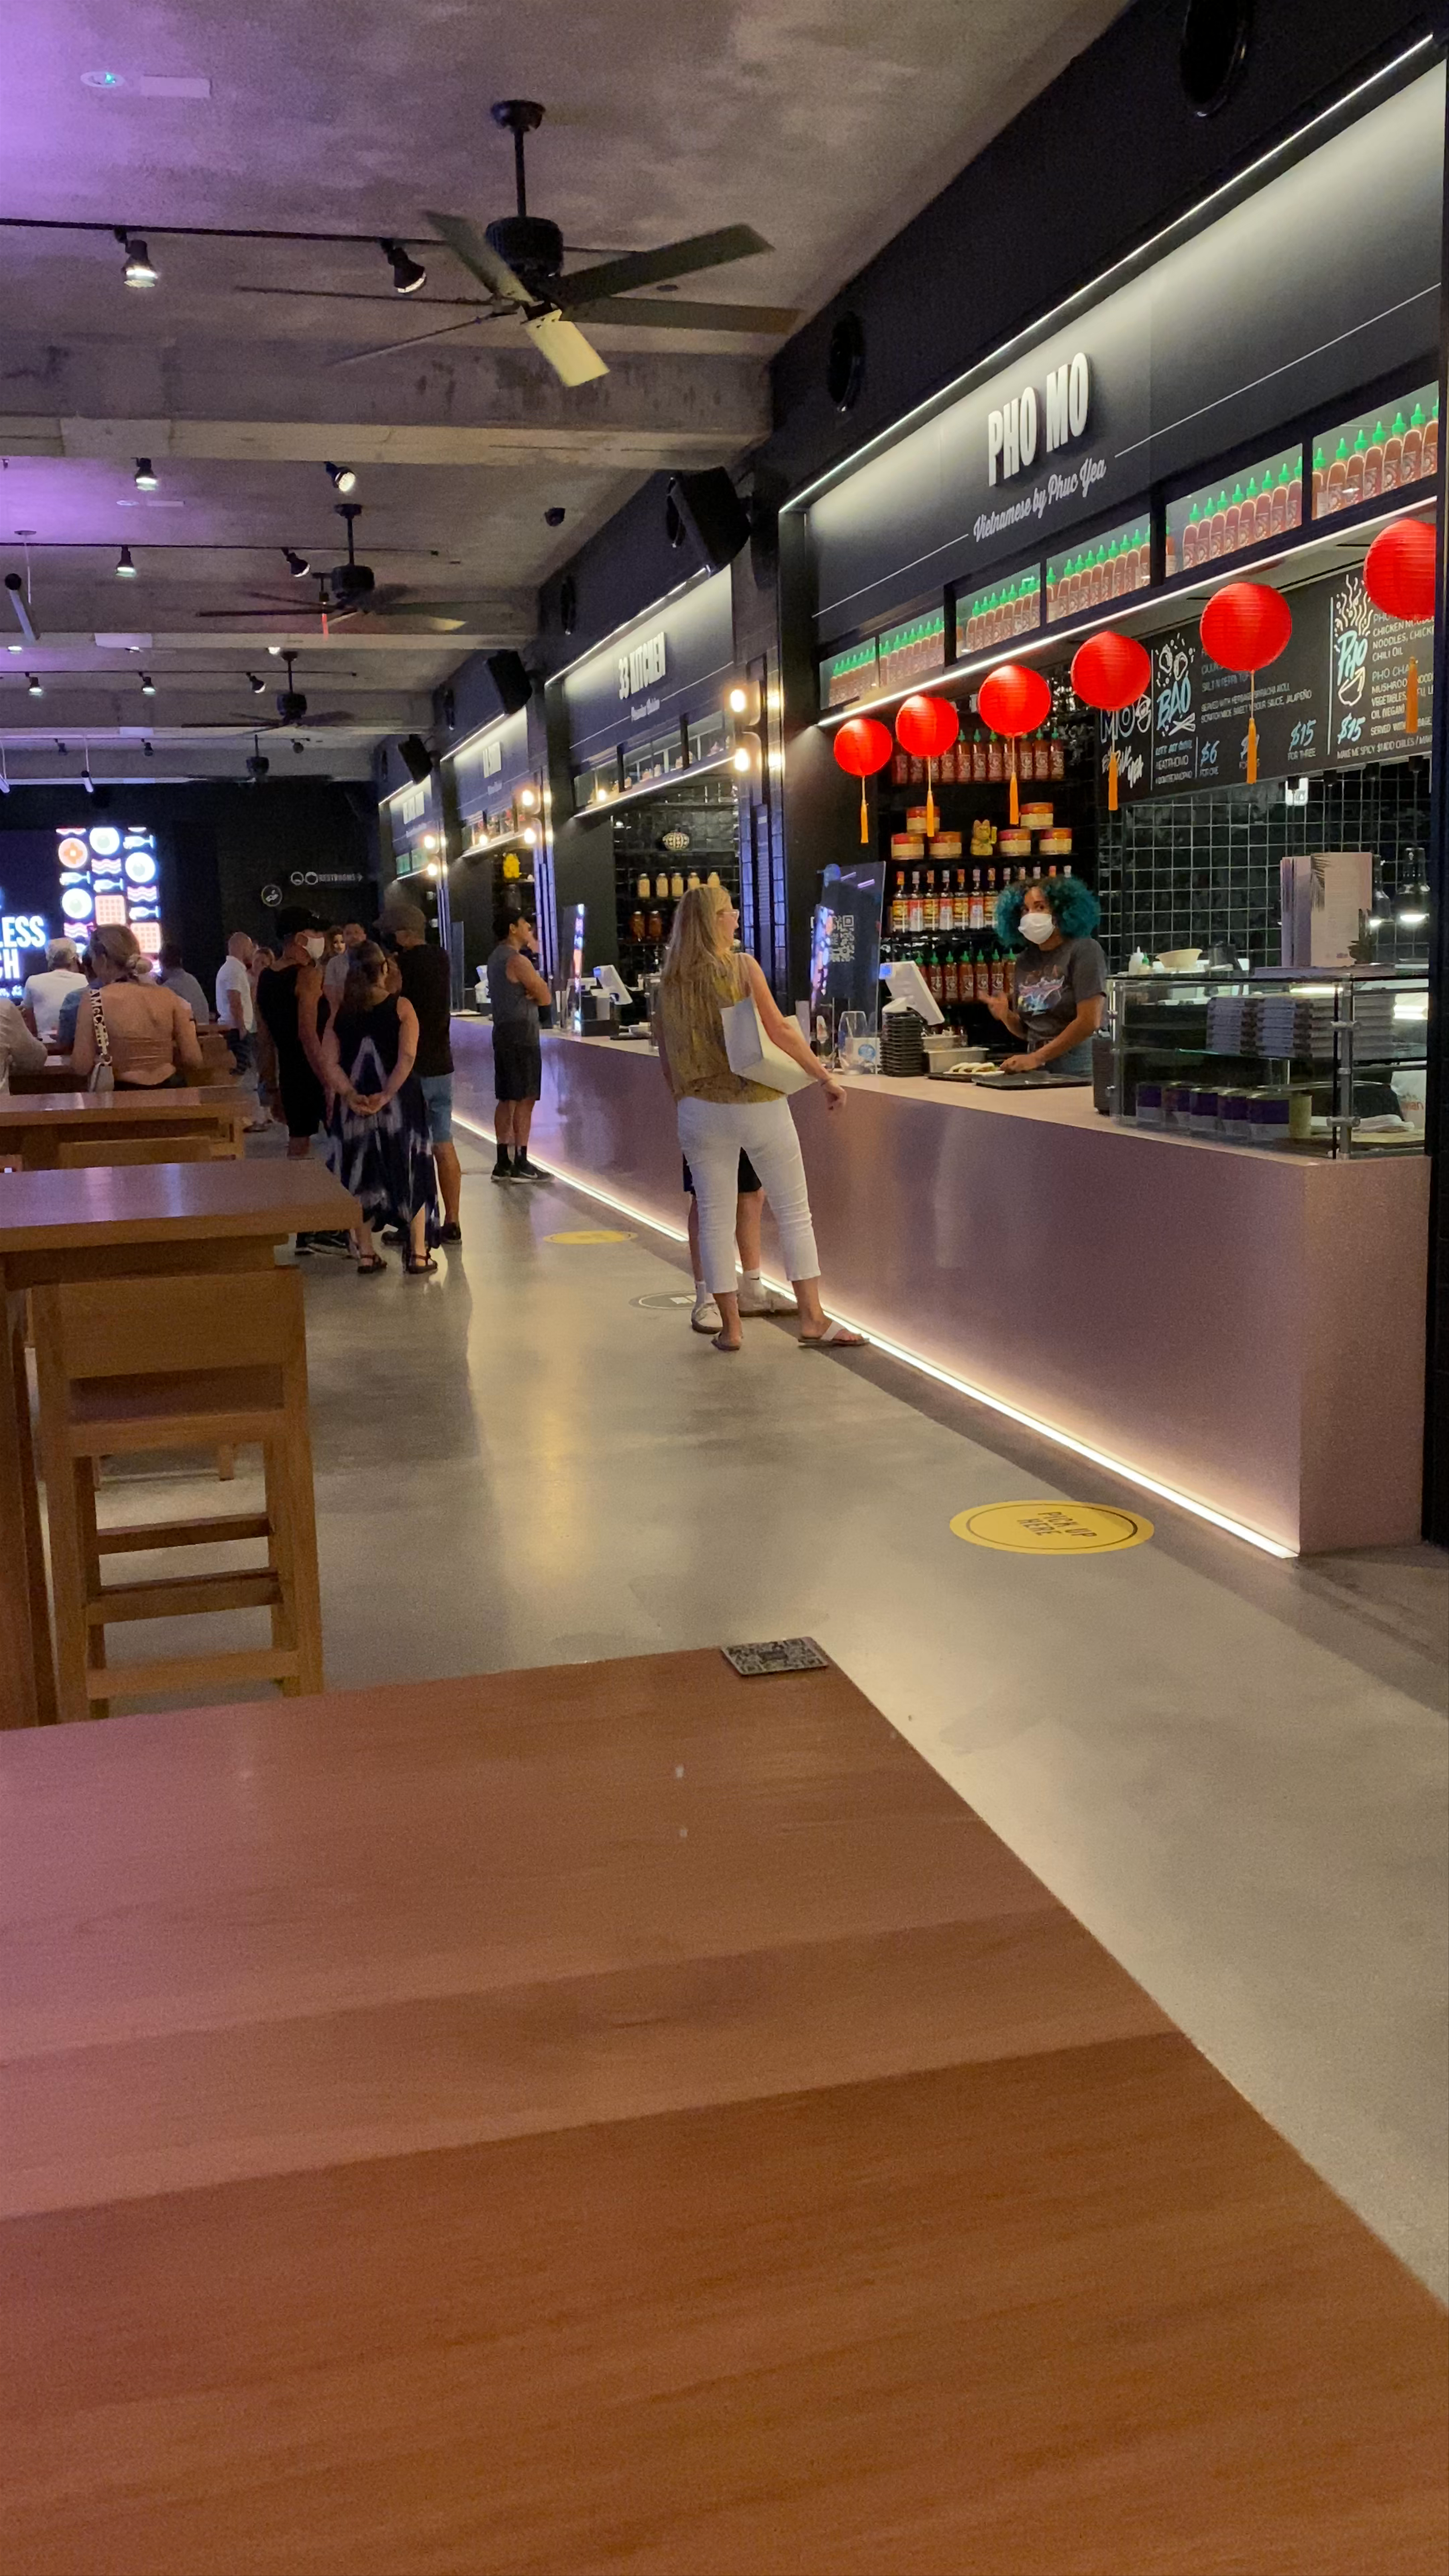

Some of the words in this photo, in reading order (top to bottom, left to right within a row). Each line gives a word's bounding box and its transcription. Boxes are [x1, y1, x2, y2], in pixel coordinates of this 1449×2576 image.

[988, 386, 1038, 486] PHO
[1046, 352, 1090, 452] MO
[973, 497, 1032, 542] Vietnamese
[1033, 487, 1048, 519] by
[1048, 473, 1078, 505] Phuc
[1079, 457, 1107, 498] Yea
[1372, 633, 1408, 649] NOODLES,
[1373, 622, 1404, 637] CHICKEN
[629, 631, 666, 695] KITCHEN
[1337, 630, 1368, 686] PHO
[1372, 651, 1391, 662] CHILI
[1371, 678, 1408, 694] MUSHROO
[1372, 668, 1390, 682] PHO
[1392, 664, 1410, 677] CHA
[1156, 675, 1191, 731] BAO
[1289, 718, 1317, 752] $15
[1337, 712, 1366, 745] $15
[1370, 724, 1391, 735] SERVED
[1200, 740, 1220, 767] $6
[1016, 1518, 1062, 1536] HERE
[1037, 1512, 1078, 1527] PICK
[1064, 1528, 1098, 1537] UP
